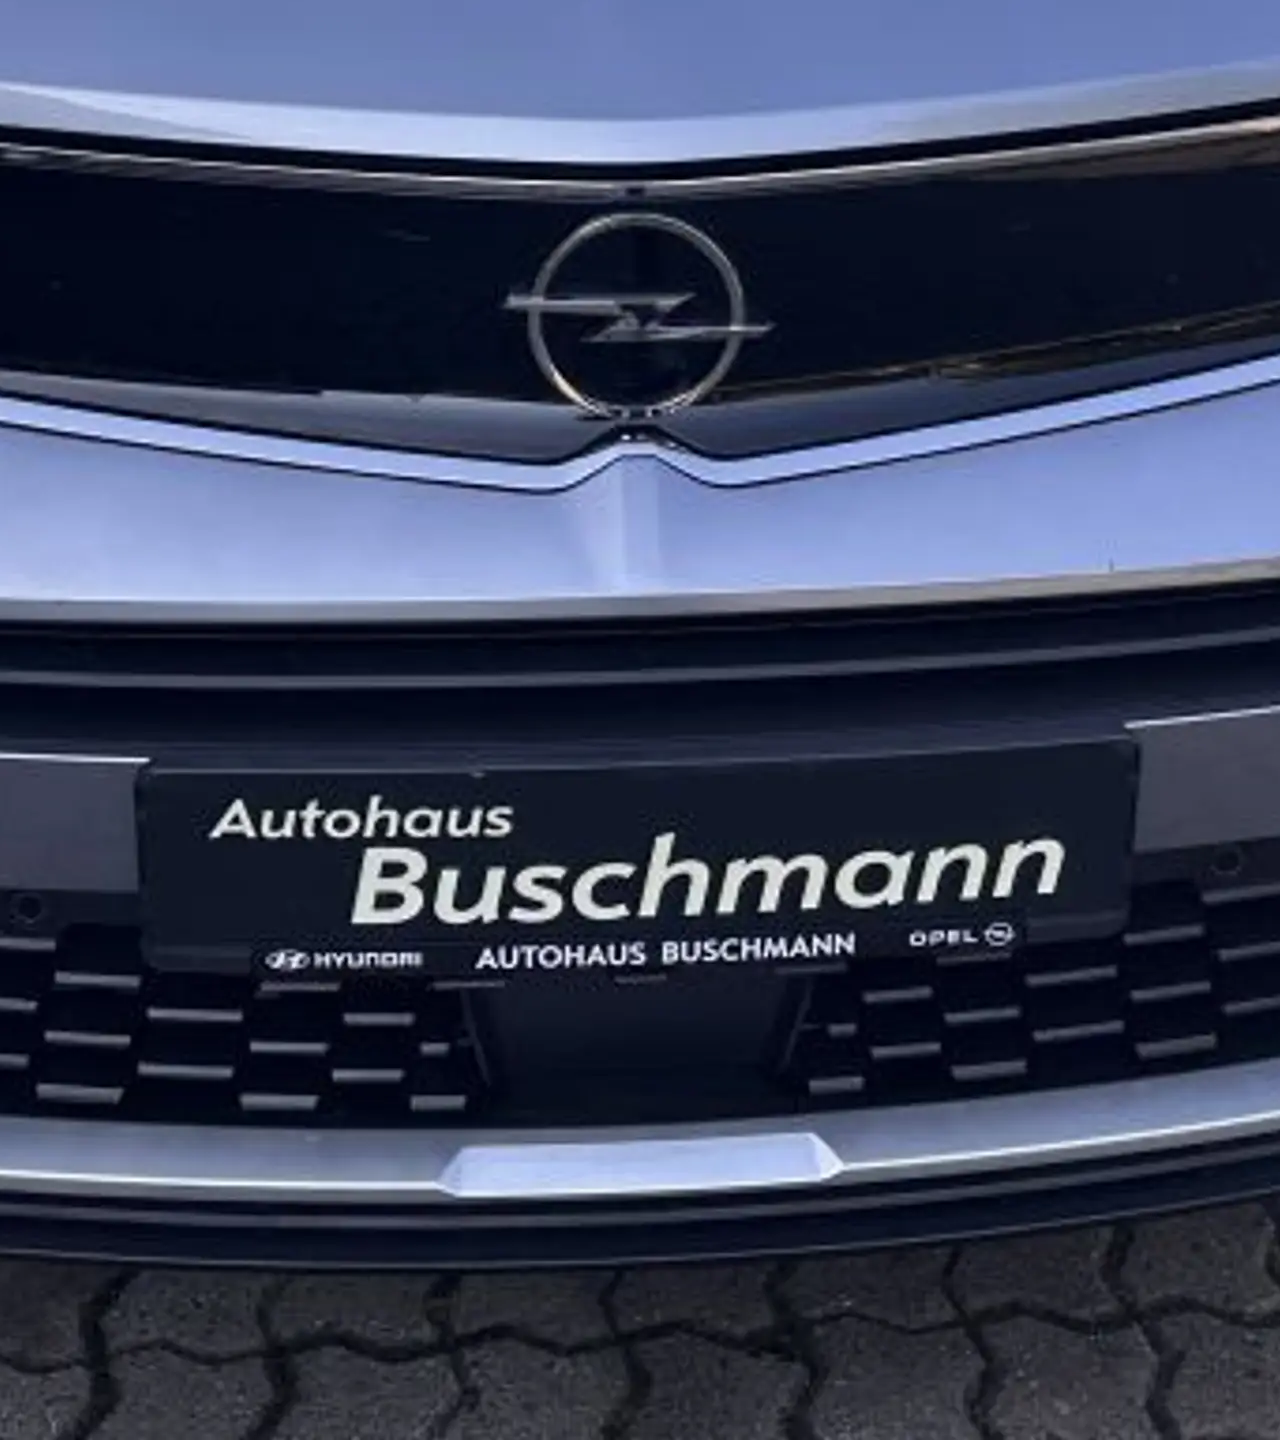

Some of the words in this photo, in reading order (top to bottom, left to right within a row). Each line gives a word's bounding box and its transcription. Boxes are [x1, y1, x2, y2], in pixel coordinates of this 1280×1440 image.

[208, 794, 514, 840] Autohaus
[350, 831, 1066, 925] Buschmann
[313, 950, 424, 969] HYUNDAI
[475, 941, 647, 971] AUTOHAUS
[660, 931, 857, 965] BUSCHMANN
[908, 924, 979, 947] OPEL
